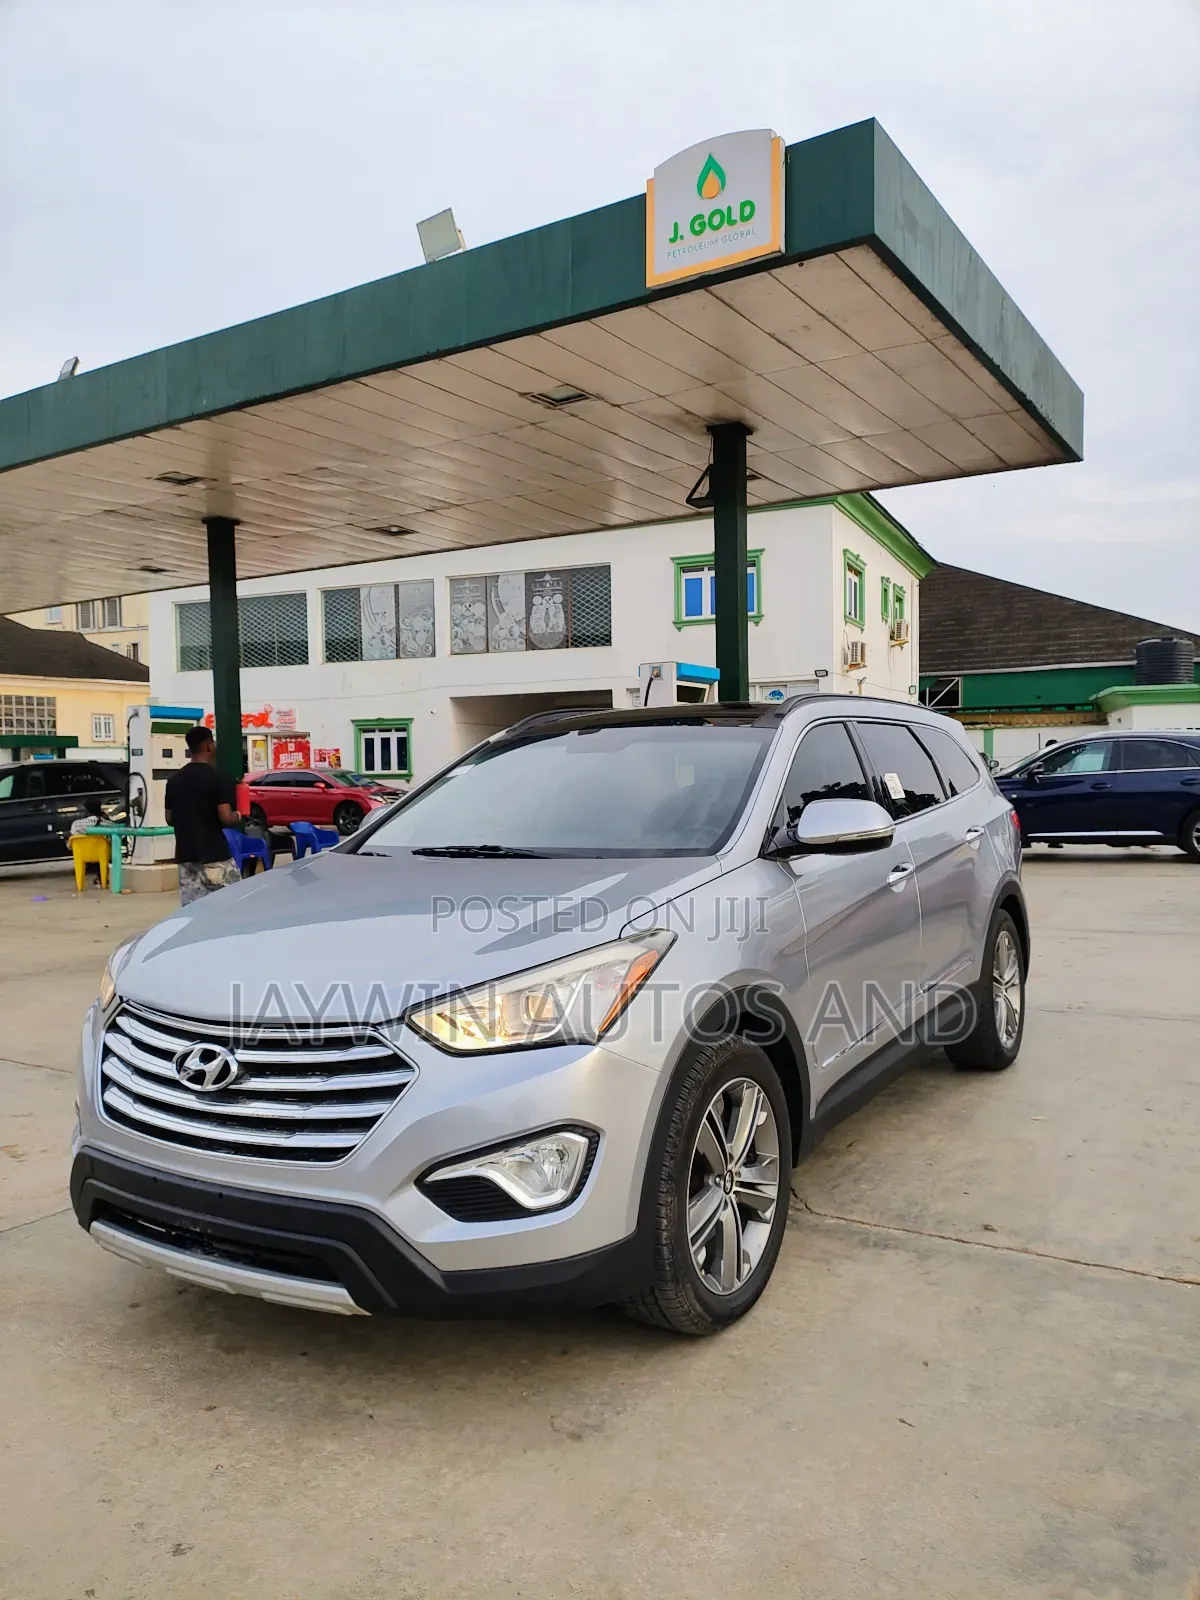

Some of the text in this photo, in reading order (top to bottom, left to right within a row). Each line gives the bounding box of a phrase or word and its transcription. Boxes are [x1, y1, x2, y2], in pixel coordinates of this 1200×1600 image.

[668, 200, 756, 244] J. GOLD
[667, 227, 757, 259] PETROLEUM GLOBAL
